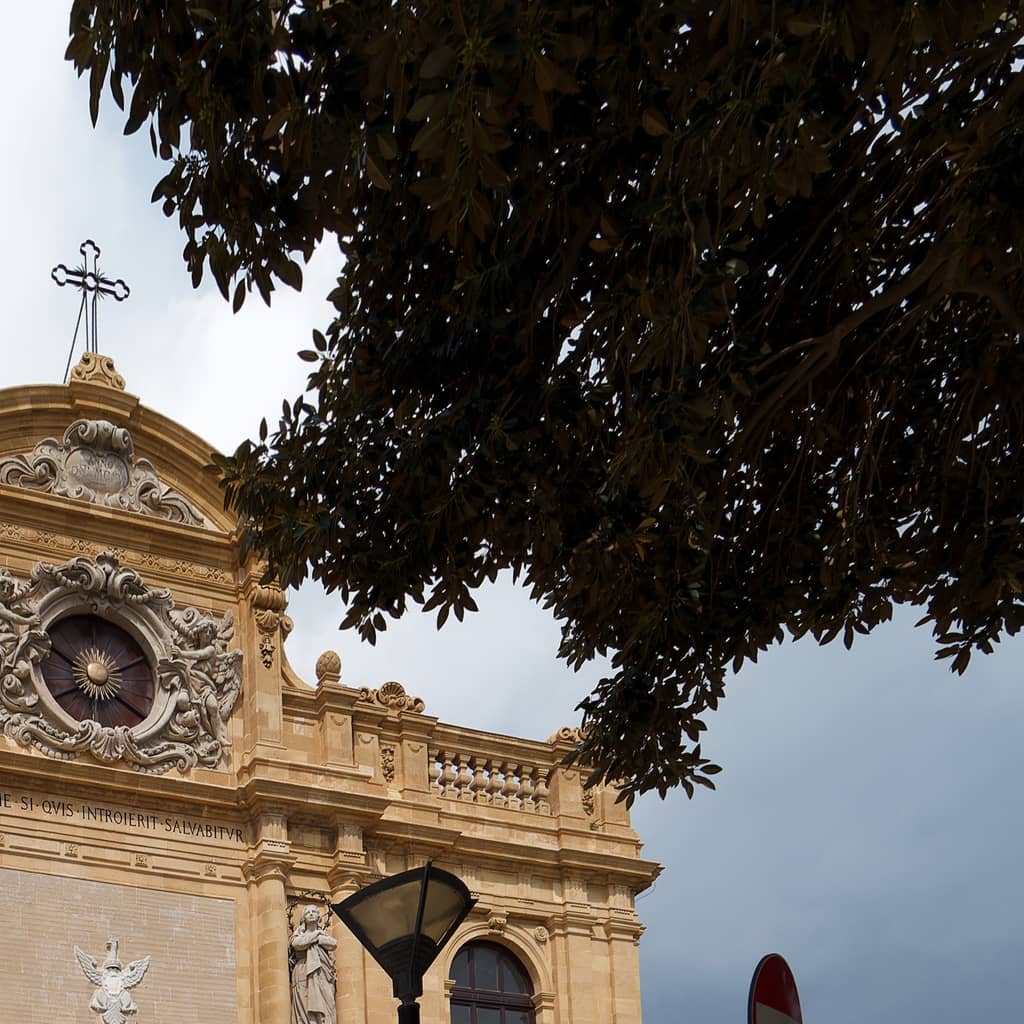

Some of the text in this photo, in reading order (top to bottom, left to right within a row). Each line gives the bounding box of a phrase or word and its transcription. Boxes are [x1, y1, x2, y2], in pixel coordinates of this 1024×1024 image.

[20, 796, 34, 811] SI
[41, 799, 74, 817] QVIS
[82, 805, 159, 830] INTROIERIT
[165, 818, 244, 843] SALVABITVR
